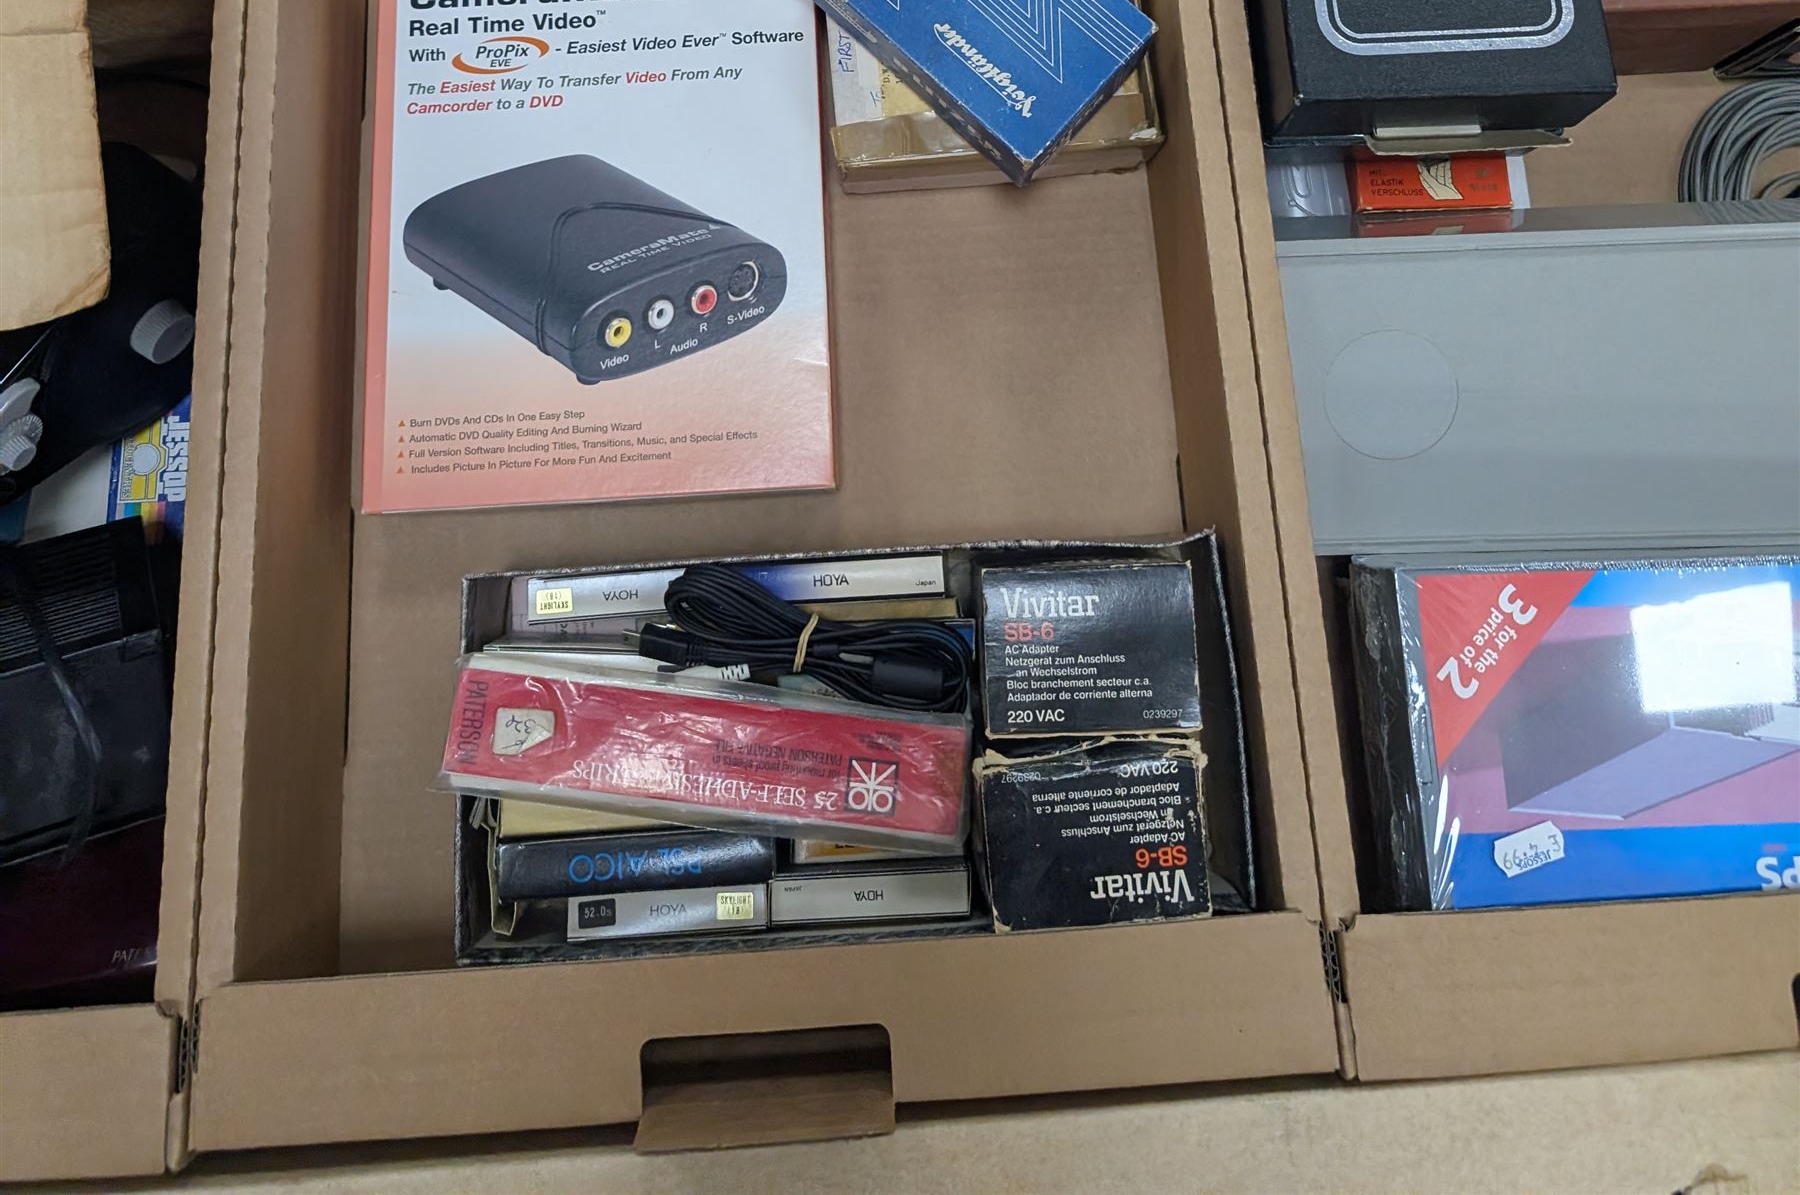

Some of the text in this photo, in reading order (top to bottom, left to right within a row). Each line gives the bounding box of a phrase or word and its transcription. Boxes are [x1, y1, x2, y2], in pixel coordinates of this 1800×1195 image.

[409, 18, 459, 37] Real
[467, 16, 525, 34] Time
[409, 48, 446, 62] With
[475, 44, 530, 59] ProPix
[566, 39, 627, 55] Easiest
[632, 37, 677, 51] Video
[731, 30, 804, 45] Software
[489, 59, 512, 68] EVE
[407, 66, 743, 95] The Easiest Way To Transfer Video From Any
[406, 95, 563, 115] Camcorder to a DVD
[1370, 179, 1404, 187] ELASTIK
[1371, 188, 1424, 197] VERSCHLUSS
[587, 229, 709, 272] CameraMate
[599, 234, 712, 274] REAL TIME VIDEO
[163, 415, 190, 502] JESSOP
[812, 574, 937, 588] HOYA Japan
[539, 588, 639, 611] HOYA SKYLIGHT
[1001, 588, 1100, 618] Vivitar
[1004, 621, 1055, 642] SB-6
[1474, 583, 1538, 674] 3 for the
[1459, 608, 1504, 670] price of
[1021, 645, 1060, 655] Adapter
[1054, 657, 1075, 665] zum
[1077, 654, 1126, 664] Anschluss
[1030, 667, 1097, 677] Wechselstrom
[1436, 656, 1480, 700] 2
[1006, 678, 1132, 690] Bloc branchement secteur
[1007, 689, 1153, 703] Adaptador de corriente alterna
[456, 679, 489, 766] PATERSON
[1007, 709, 1065, 723] 220 VAC
[1142, 709, 1183, 719] 0239297
[789, 749, 842, 766] PATERSON
[1152, 760, 1179, 775] 220
[812, 790, 839, 811] 25
[1032, 782, 1180, 802] Adaptador de corriente alterna
[1092, 795, 1182, 810] Bloc branchement
[1089, 811, 1159, 822] Wechselstrom
[1061, 827, 1111, 837] Anschluss
[1112, 824, 1134, 832] zum
[1129, 833, 1168, 845] Adapter
[1135, 845, 1189, 869] SB-6
[854, 890, 884, 901] HOYA
[1090, 869, 1195, 904] Vivitar
[649, 896, 751, 916] HOYA SKYLIGHT
